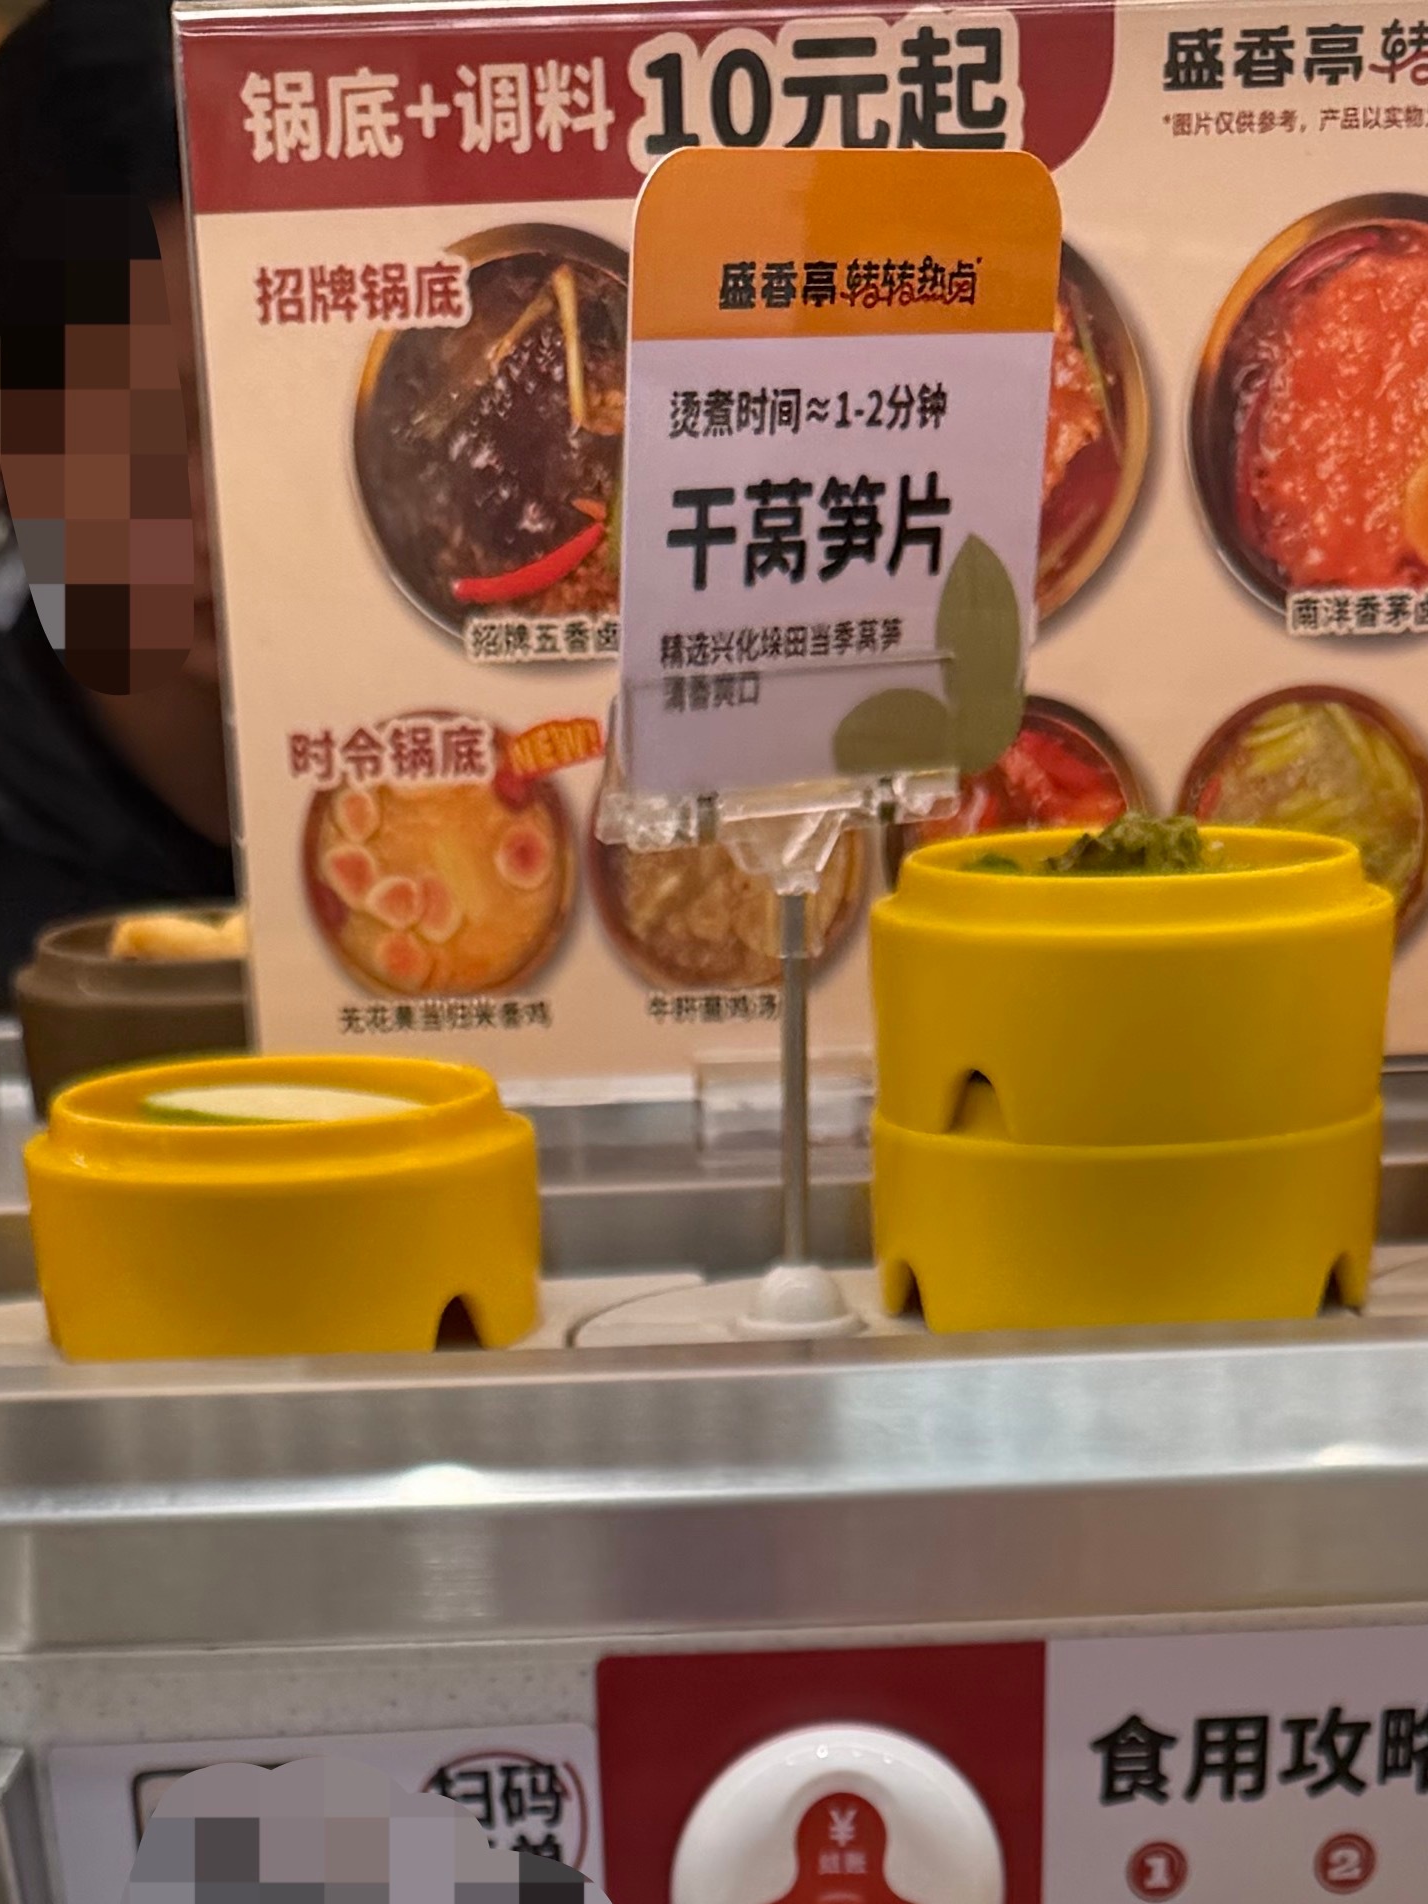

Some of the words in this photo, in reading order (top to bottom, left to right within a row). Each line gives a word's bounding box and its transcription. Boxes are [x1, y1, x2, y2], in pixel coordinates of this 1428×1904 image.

[241, 58, 616, 162] 锅底+调料
[644, 27, 1008, 155] 10元起
[255, 263, 467, 325] 招牌锅底
[669, 382, 948, 440] 烫煮时间≈1-2分钟
[666, 471, 952, 592] 干莴笋片
[287, 727, 487, 780] 时令锅底
